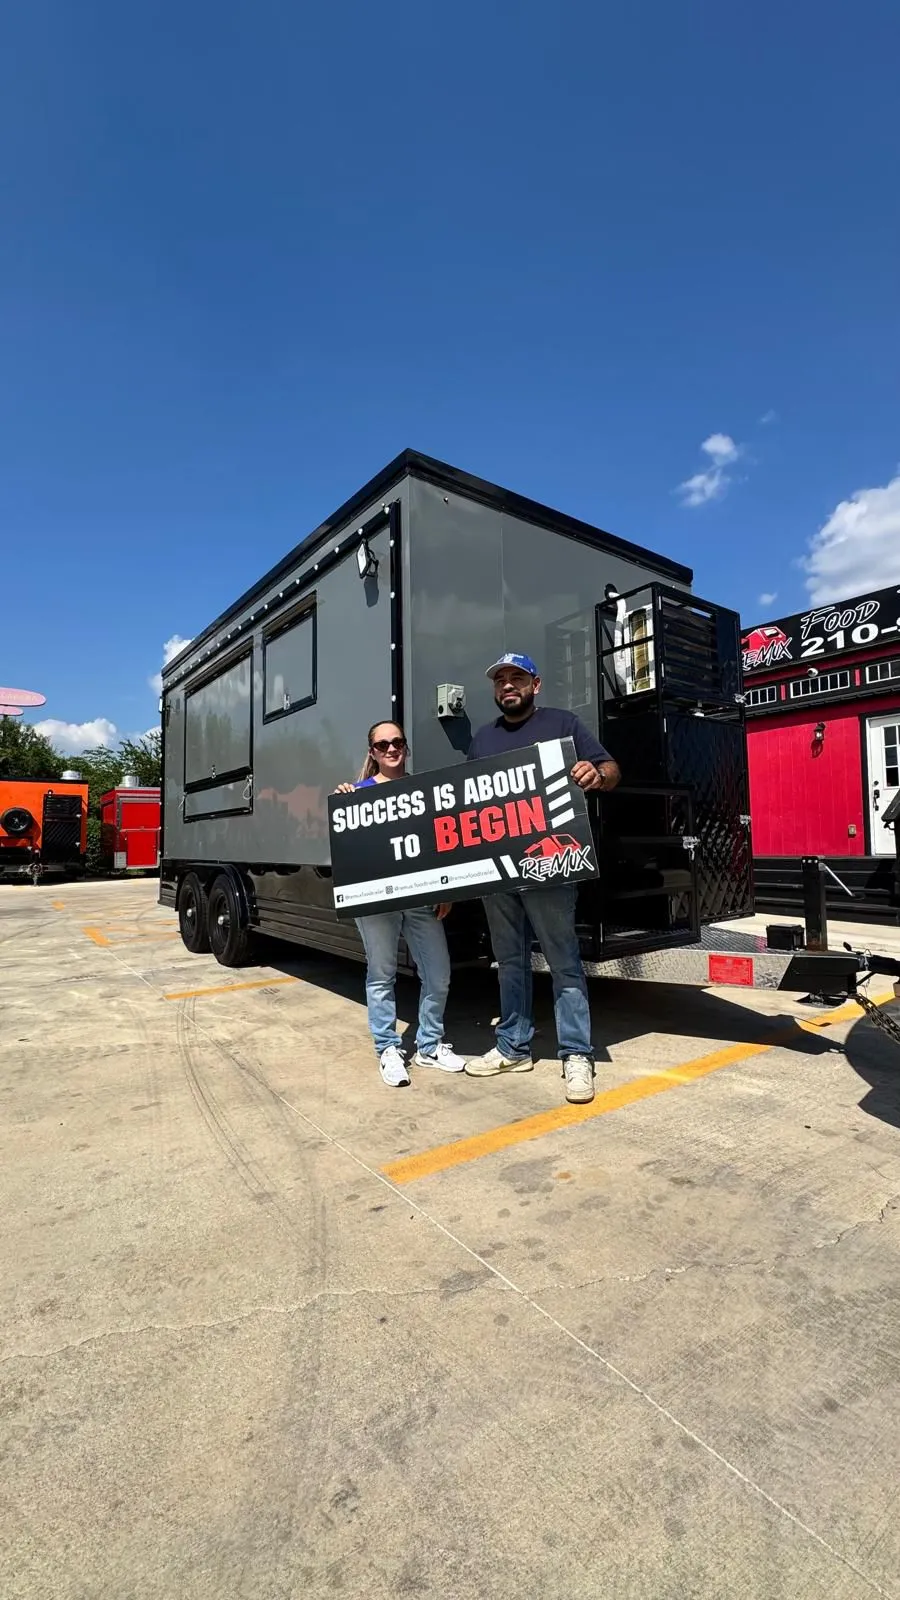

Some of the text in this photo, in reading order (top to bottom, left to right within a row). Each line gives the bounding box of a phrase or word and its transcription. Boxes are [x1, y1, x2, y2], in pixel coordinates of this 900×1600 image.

[801, 601, 880, 639] FOOD
[801, 617, 900, 658] 210-
[333, 764, 537, 833] SUCCESS IS ABOUT
[390, 796, 547, 861] TO BEGIN
[519, 845, 595, 881] REMUX
